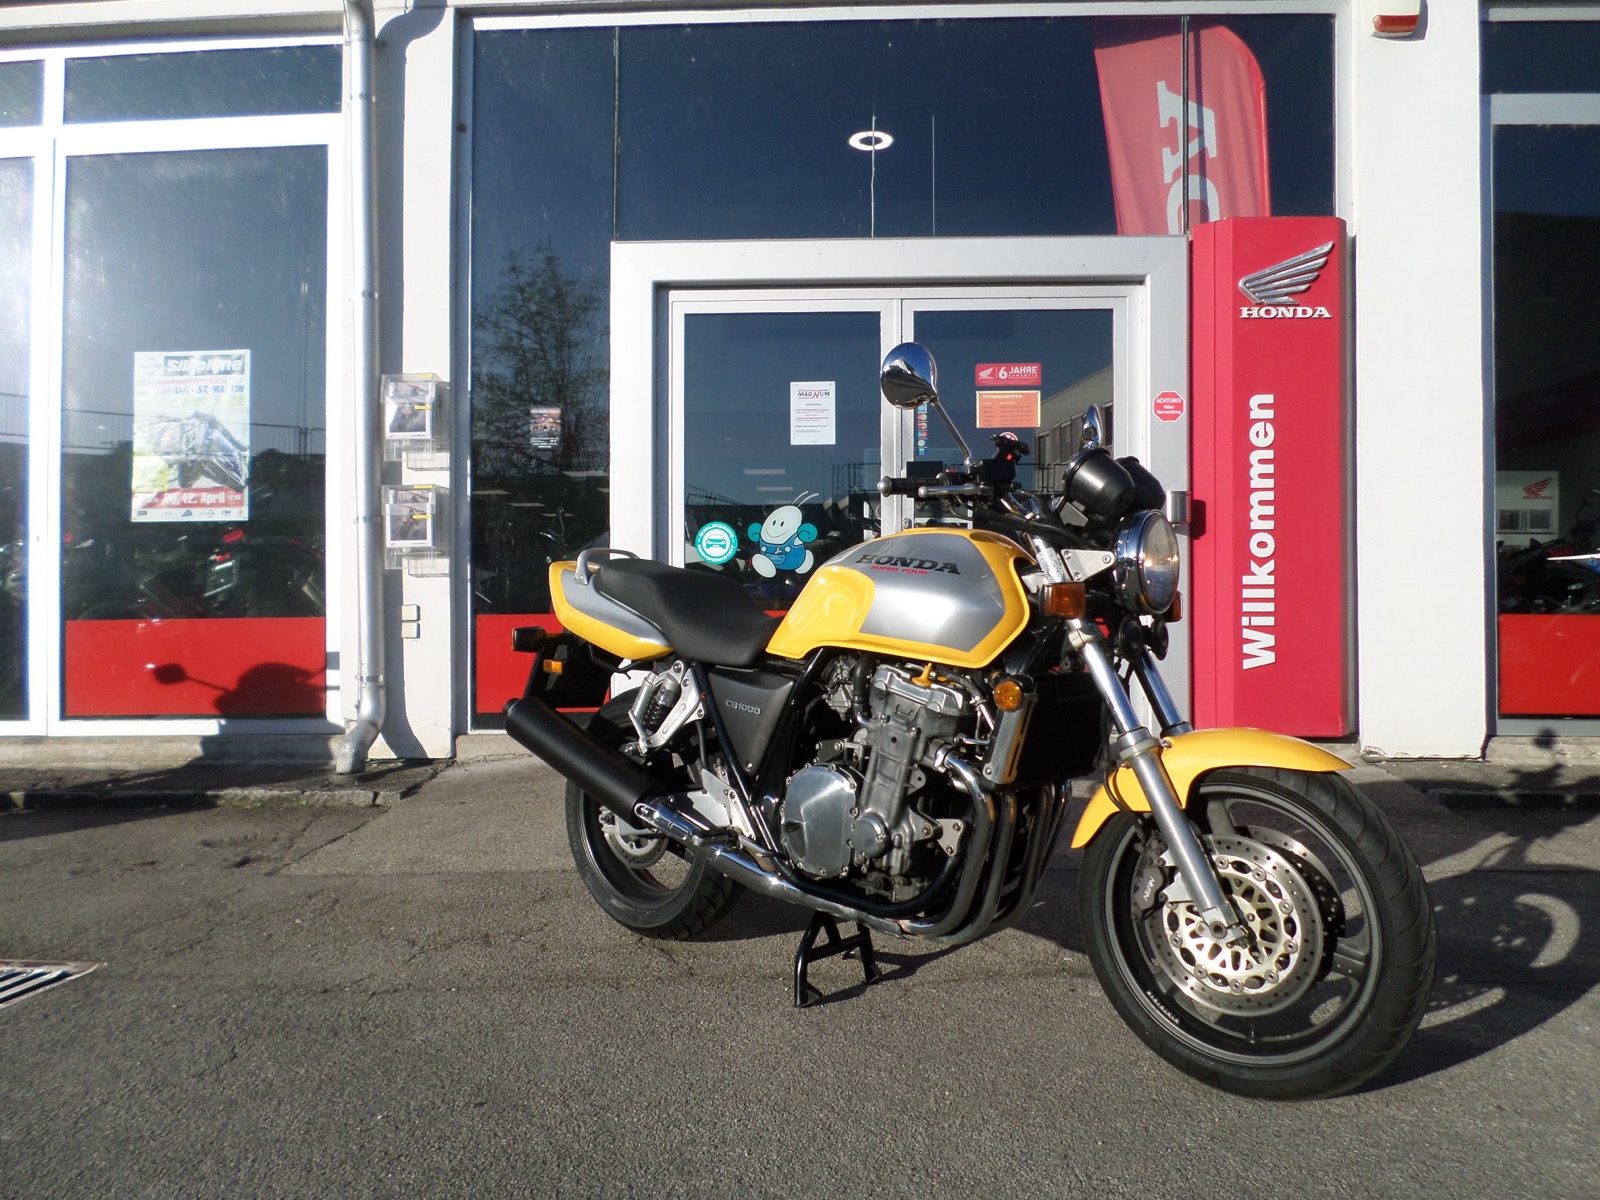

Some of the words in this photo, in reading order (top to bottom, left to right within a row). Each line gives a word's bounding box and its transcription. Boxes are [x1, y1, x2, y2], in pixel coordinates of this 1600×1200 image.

[1239, 306, 1332, 319] HONDA
[998, 366, 1008, 379] 6
[1009, 366, 1038, 374] JAHRE
[797, 391, 831, 399] MAGNUM
[200, 491, 225, 505] April
[1241, 393, 1276, 671] Willkommen
[855, 554, 962, 575] HONDA
[725, 700, 761, 715] CB1000
